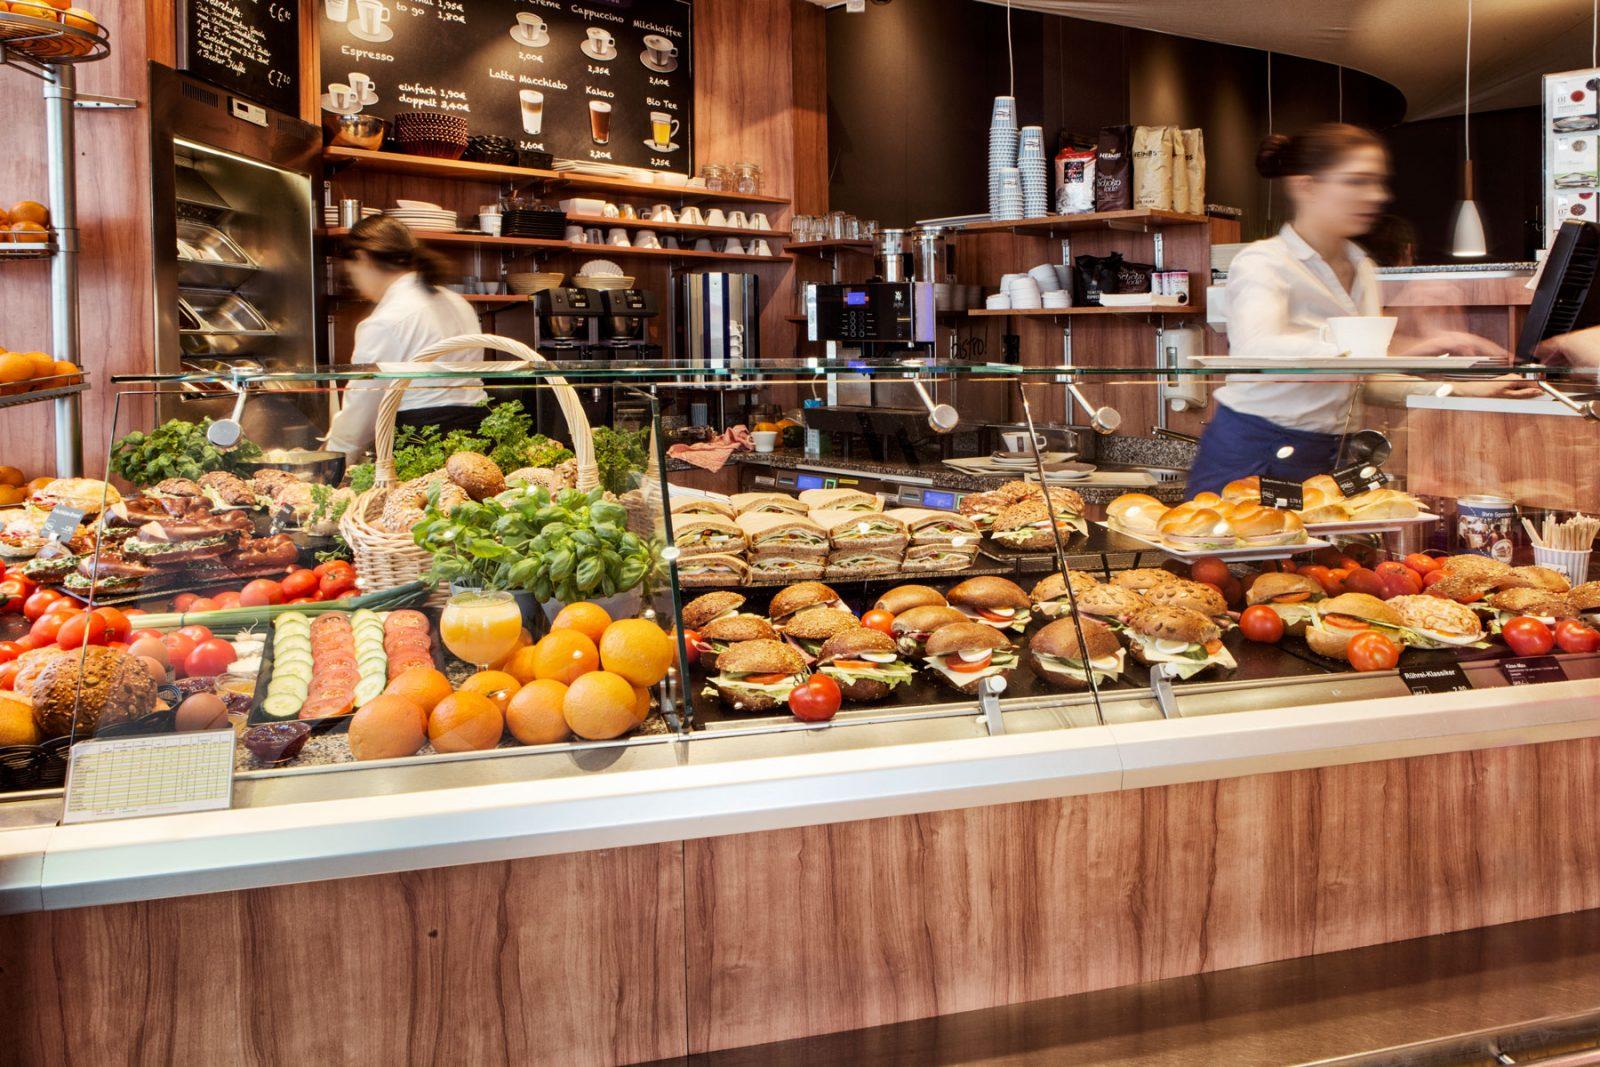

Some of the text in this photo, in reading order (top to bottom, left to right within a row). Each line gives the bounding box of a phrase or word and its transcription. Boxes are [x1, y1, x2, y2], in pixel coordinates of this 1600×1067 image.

[396, 3, 407, 12] to
[411, 7, 424, 17] go
[571, 4, 624, 24] Cappuccino
[633, 19, 682, 38] Milchkaffee
[341, 45, 395, 62] Espresso
[518, 51, 544, 64] 2,00€
[489, 68, 568, 91] Latte Macchiato
[649, 77, 670, 87] 2,60€
[398, 82, 467, 100] einfach 1,90€
[585, 86, 615, 99] Kakao
[398, 94, 471, 112] doppelt 3,40€
[646, 97, 678, 110] Bio Tee
[519, 140, 545, 152] 2,60€
[589, 150, 612, 160] 2,20€
[1403, 669, 1456, 680] Rührei-Klassiker
